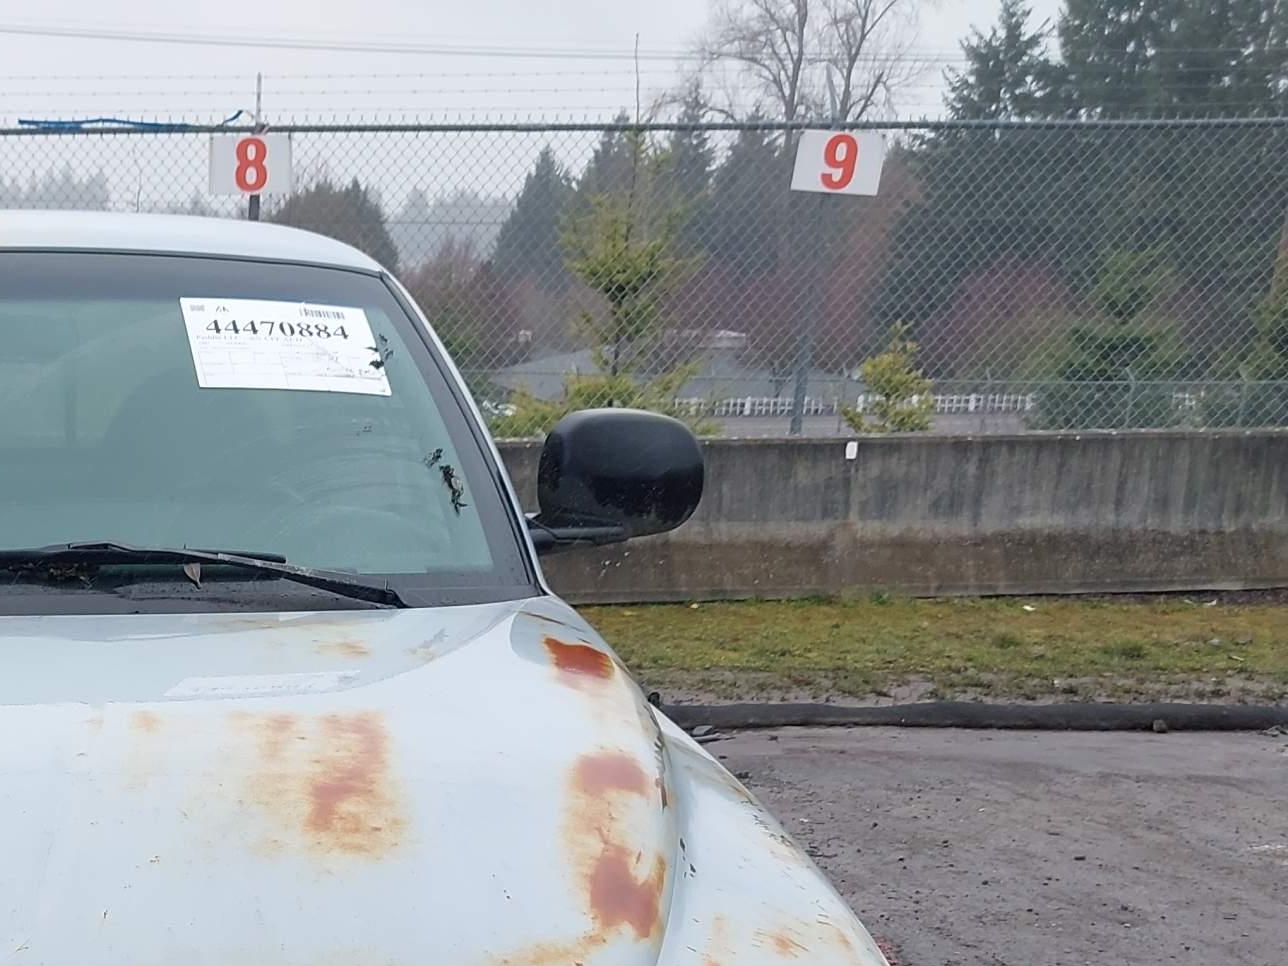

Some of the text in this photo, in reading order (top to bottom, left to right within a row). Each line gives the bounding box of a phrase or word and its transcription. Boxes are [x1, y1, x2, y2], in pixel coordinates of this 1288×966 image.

[235, 138, 267, 192] 8
[821, 134, 858, 189] 9
[206, 319, 348, 339] 44470884
